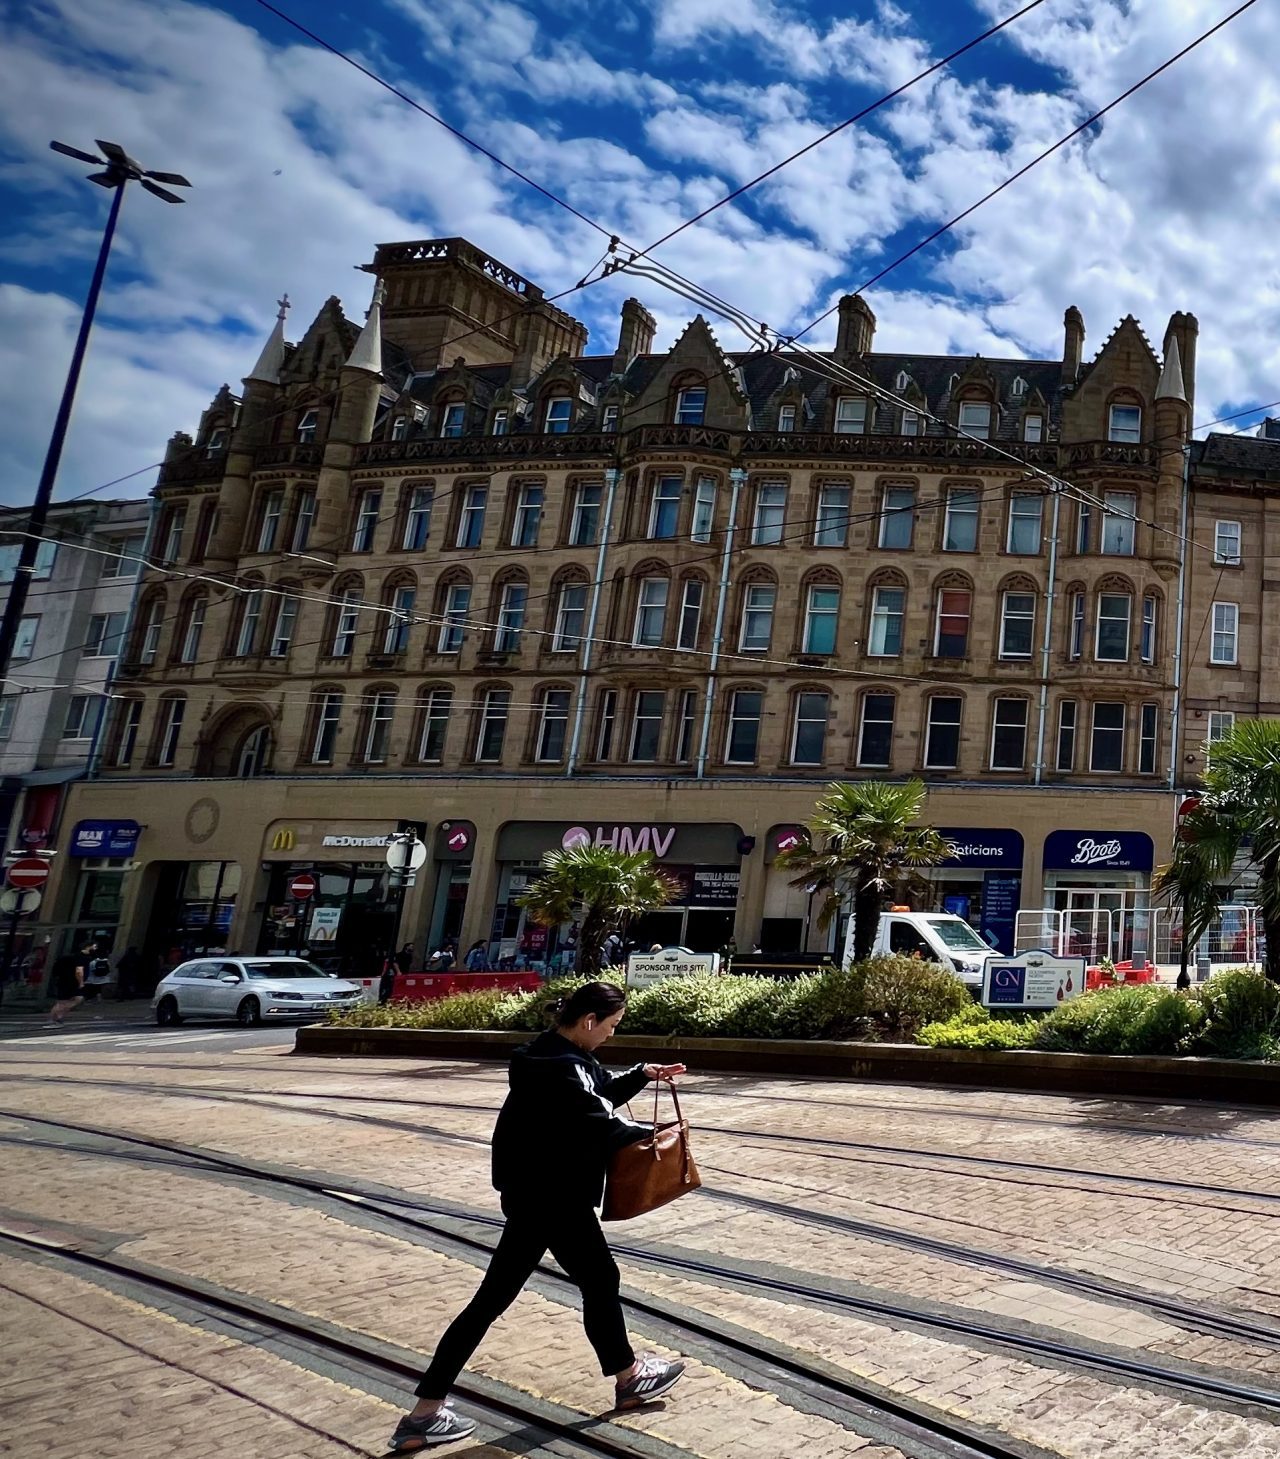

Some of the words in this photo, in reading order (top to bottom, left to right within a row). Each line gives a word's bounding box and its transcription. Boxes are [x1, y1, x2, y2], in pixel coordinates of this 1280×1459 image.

[594, 826, 676, 858] HMV
[1070, 838, 1122, 864] Boots
[635, 964, 671, 972] SPONSOR
[672, 964, 688, 972] THIS
[995, 969, 1021, 987] GN
